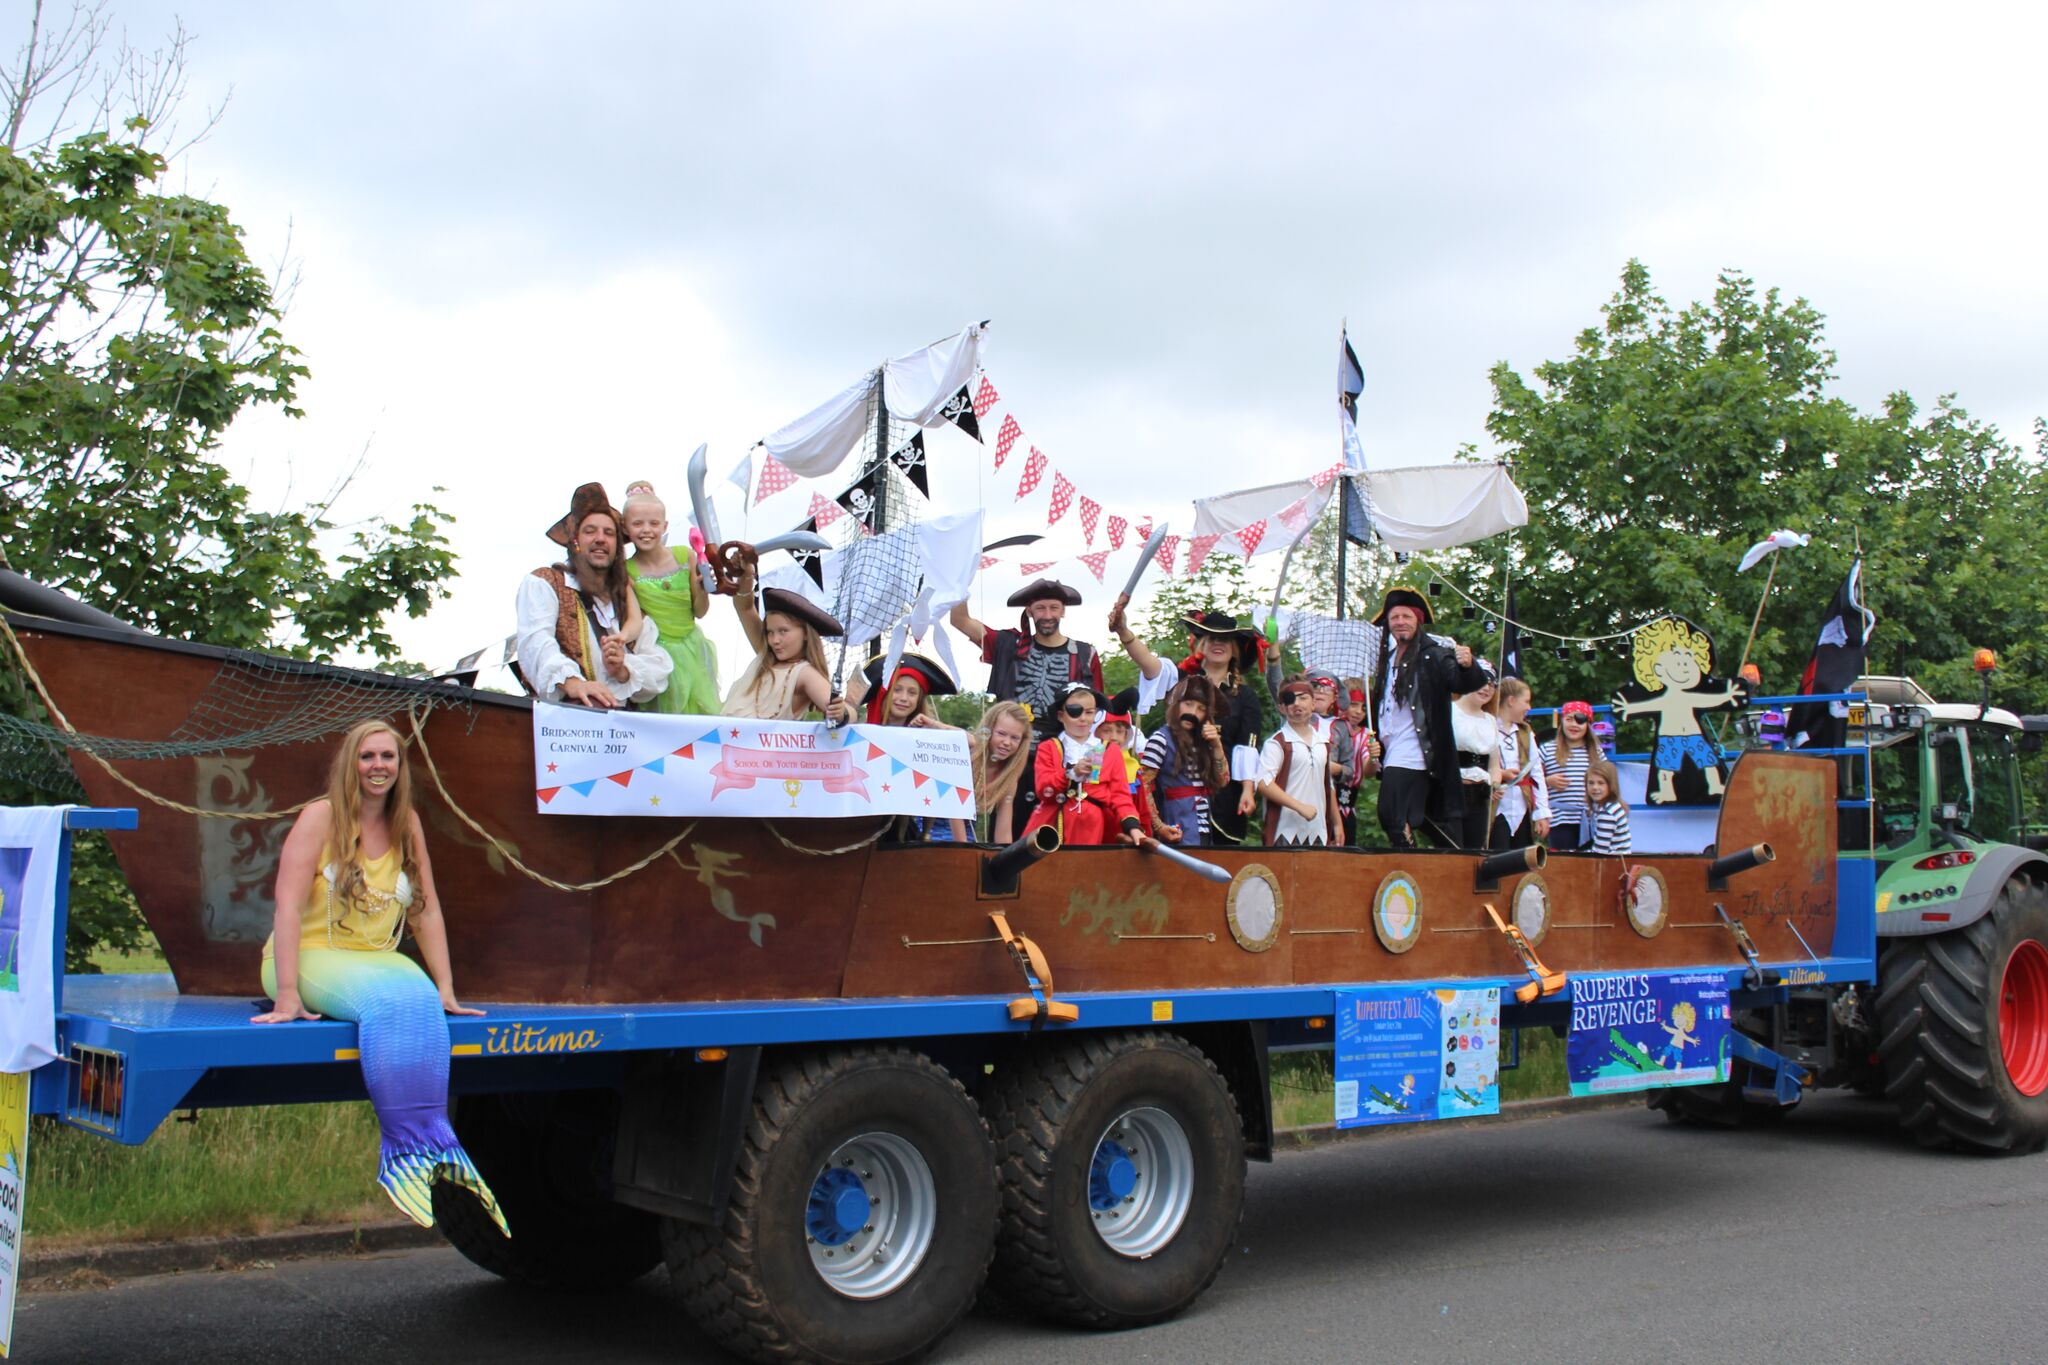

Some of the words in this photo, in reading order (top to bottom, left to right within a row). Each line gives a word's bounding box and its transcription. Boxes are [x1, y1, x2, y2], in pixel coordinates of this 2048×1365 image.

[541, 726, 603, 739] BRIDGNORTH
[609, 728, 636, 740] TOWN
[758, 733, 817, 749] WINNER
[550, 742, 599, 754] CARNIVAL
[604, 744, 628, 754] 2017
[912, 753, 930, 763] AMD
[1788, 968, 1827, 985] Ultima
[1572, 974, 1650, 1004] RUPERT'S
[1572, 999, 1662, 1031] REVENGE!
[487, 1023, 603, 1054] Ultima
